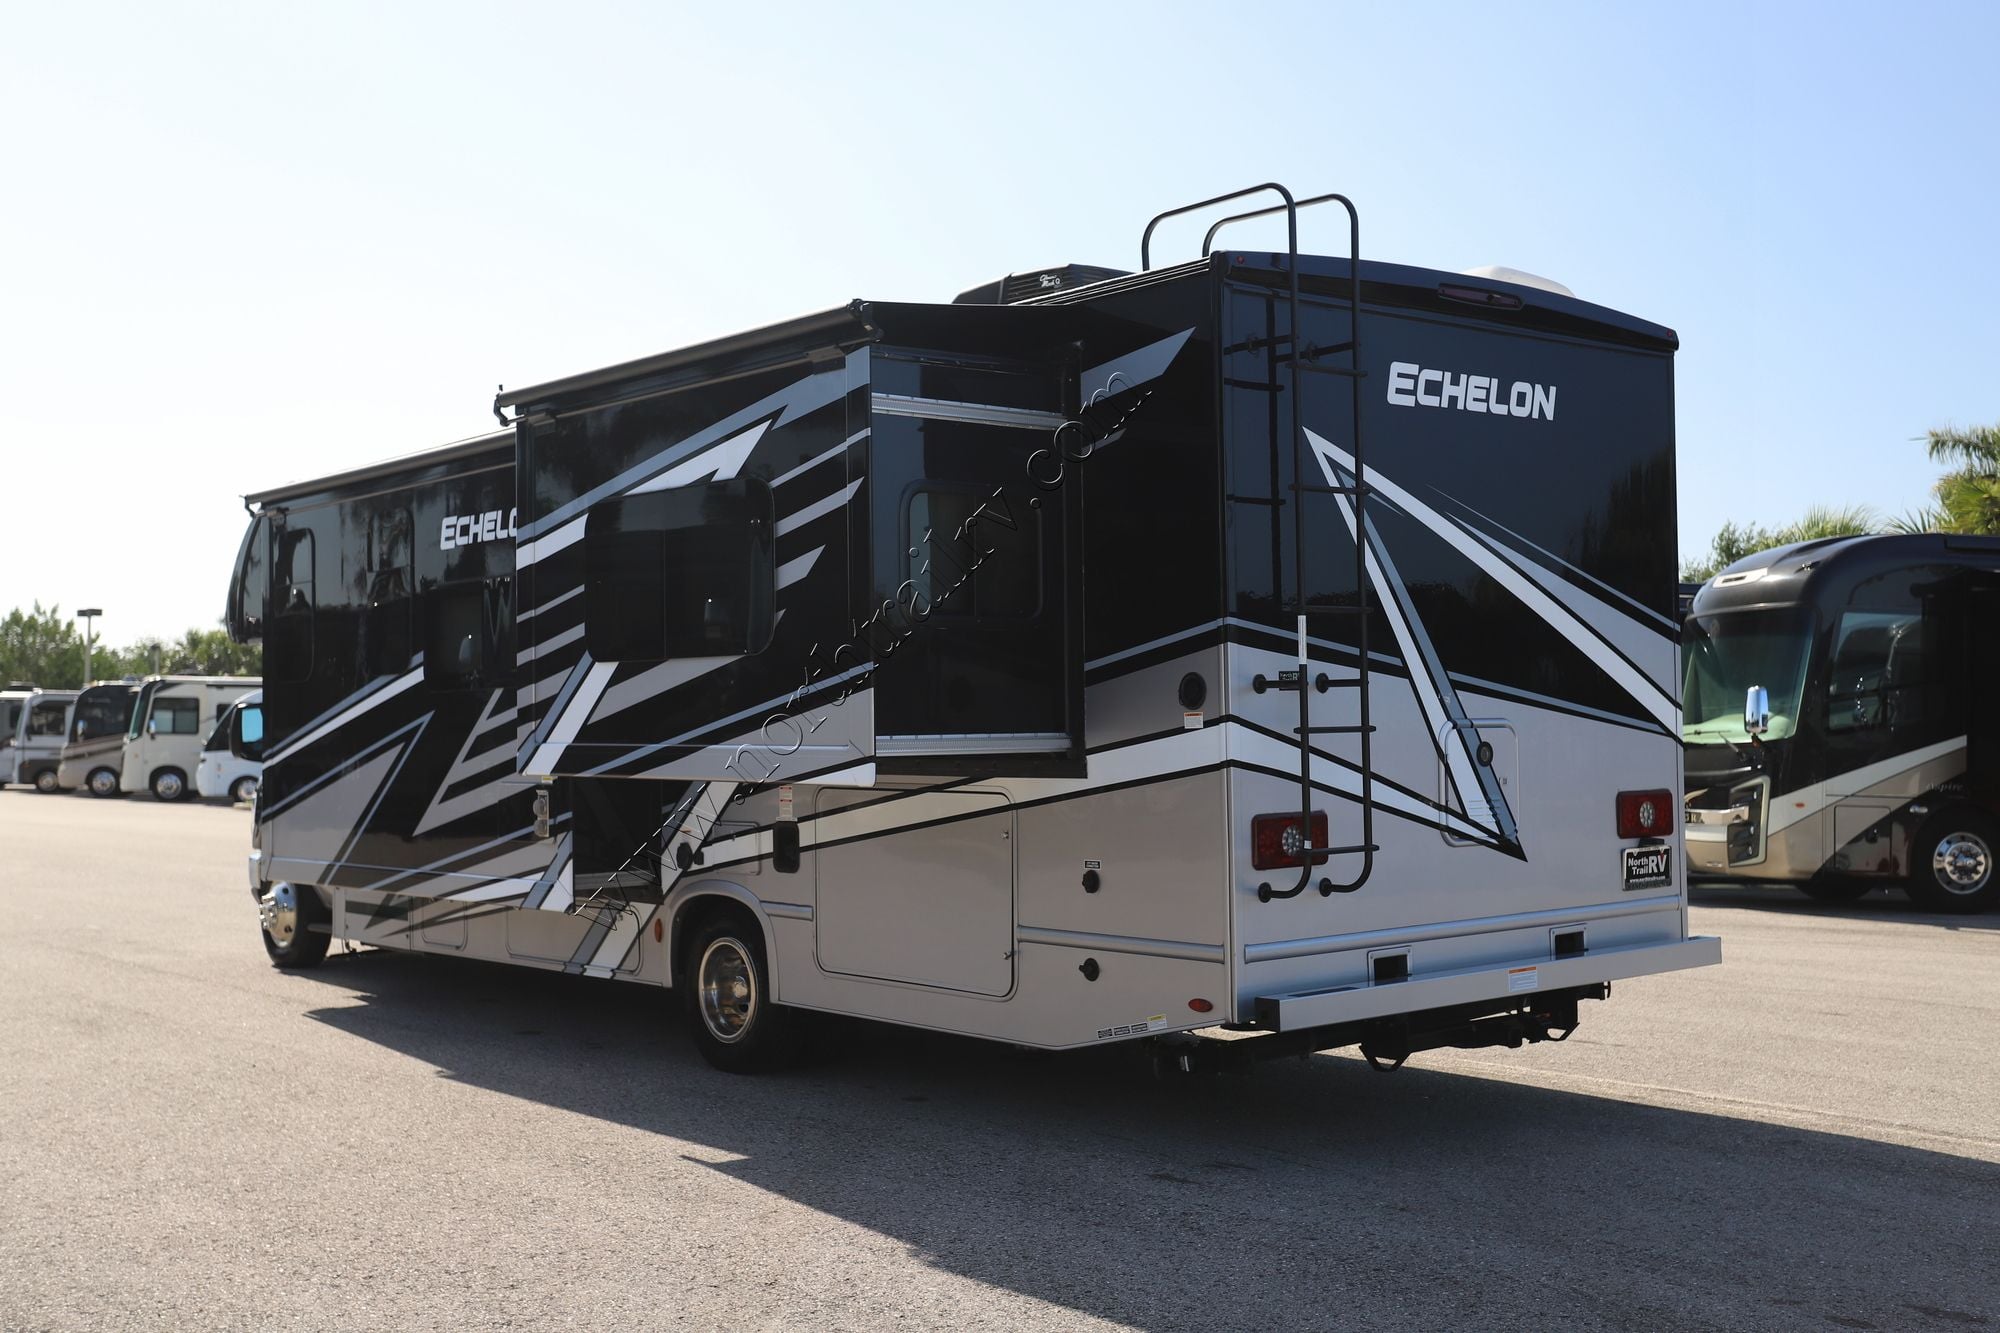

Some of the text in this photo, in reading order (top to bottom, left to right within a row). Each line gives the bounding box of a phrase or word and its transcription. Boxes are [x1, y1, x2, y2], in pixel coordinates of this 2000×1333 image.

[1386, 360, 1557, 421] ECHELON
[440, 507, 517, 551] ECHELO
[1292, 672, 1300, 681] R
[1628, 856, 1649, 867] North
[1648, 854, 1667, 874] RV
[1632, 865, 1649, 876] Trail
